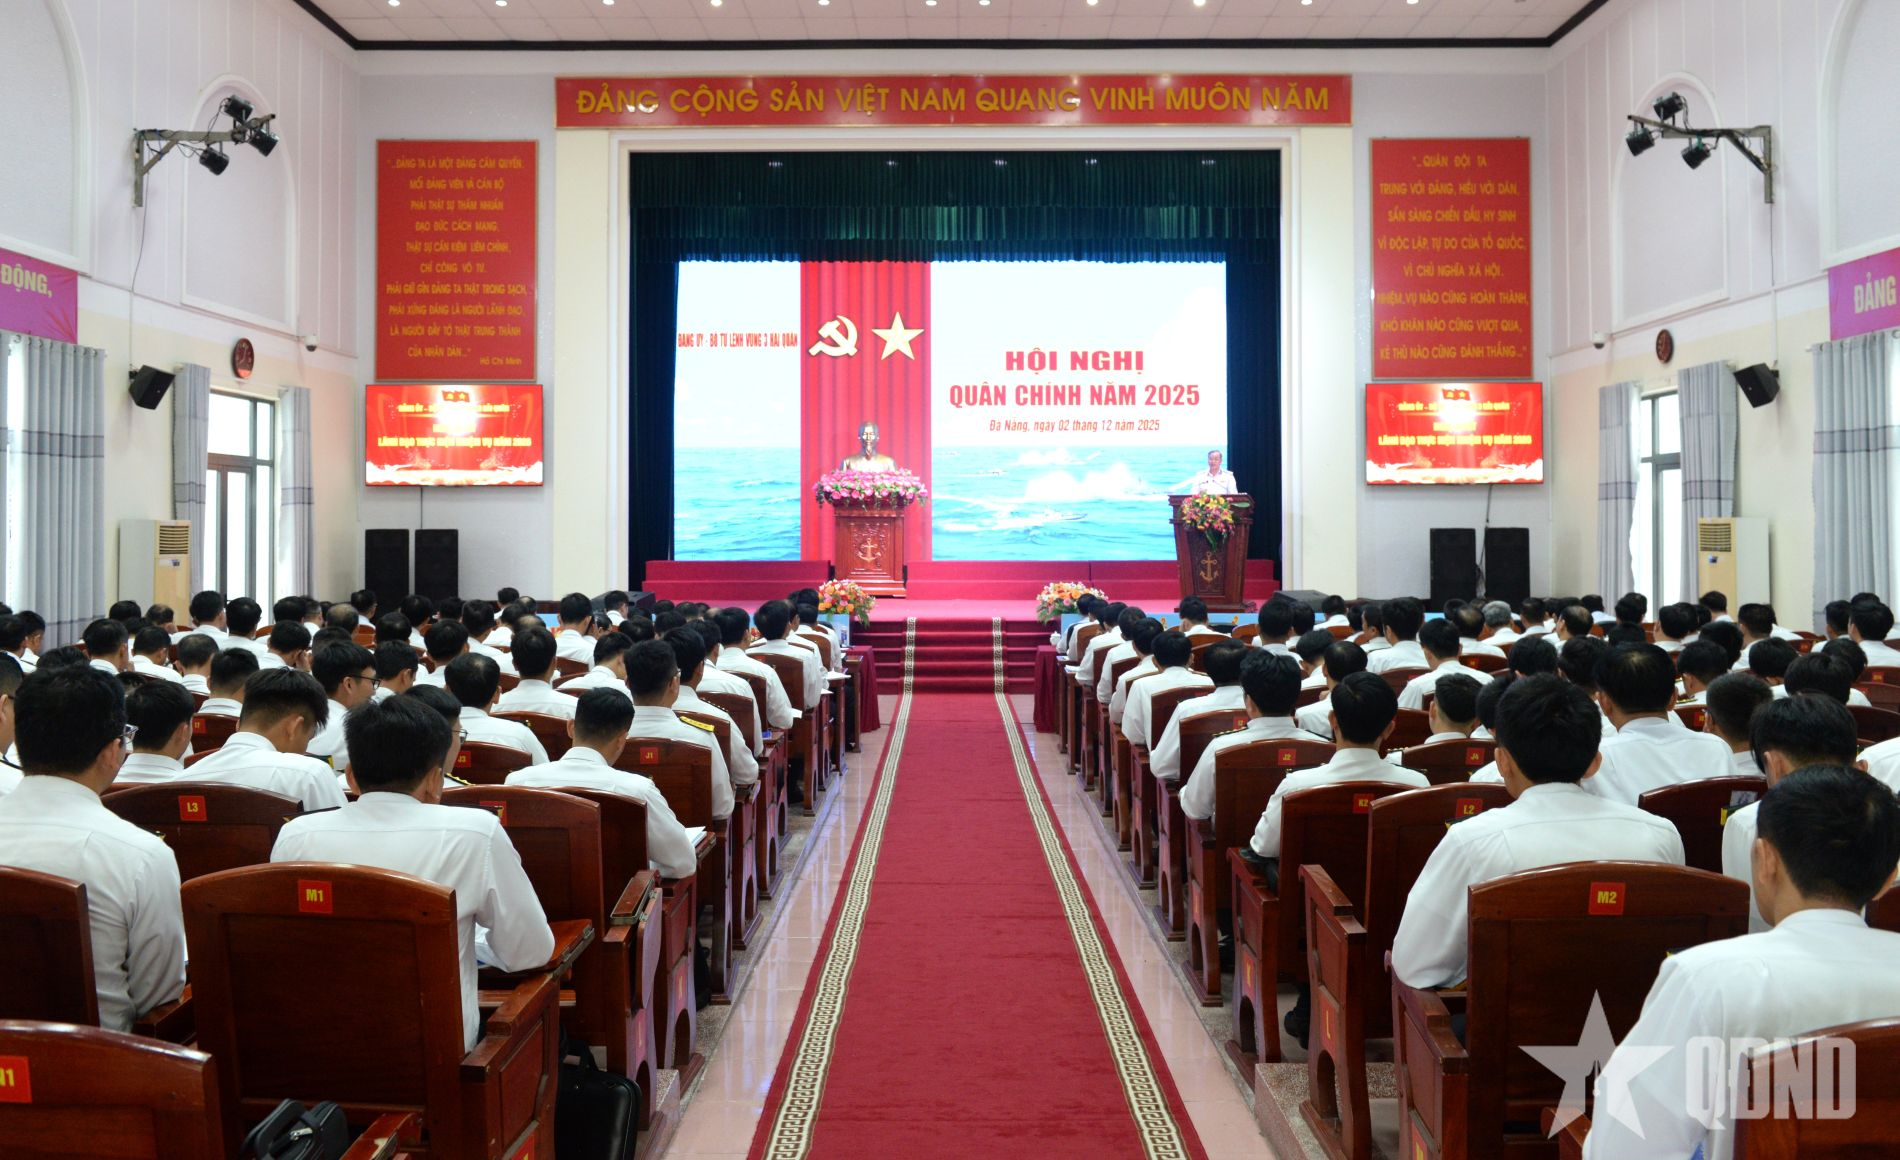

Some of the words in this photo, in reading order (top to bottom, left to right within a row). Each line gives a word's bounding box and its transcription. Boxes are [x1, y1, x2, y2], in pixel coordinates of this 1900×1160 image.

[577, 84, 659, 114] ĐẢNG
[670, 84, 759, 118] CỘNG
[769, 81, 824, 112] SẢN
[836, 83, 889, 116] VIỆT
[901, 87, 966, 112] NAM
[975, 87, 1080, 112] QUANG
[1090, 86, 1155, 111] VINH
[1165, 82, 1251, 110] MUÔN
[1262, 82, 1329, 110] NĂM
[0, 263, 53, 299] ĐỘNG,
[1853, 271, 1897, 314] ĐẢNG
[1005, 347, 1057, 375] HỘI
[1070, 350, 1144, 375] NGHỊ
[949, 381, 1007, 408] QUÂN
[1015, 382, 1081, 406] CHÍNH
[1090, 381, 1136, 406] NĂM
[1144, 384, 1200, 406] 2025
[1058, 419, 1070, 431] 02
[1101, 419, 1112, 431] 12
[1138, 419, 1160, 431] 2025
[1282, 753, 1292, 761] J2
[187, 802, 199, 813] L3
[1358, 798, 1369, 807] K2
[1463, 804, 1476, 815] L2
[306, 888, 324, 902] M1
[1597, 891, 1617, 904] M2
